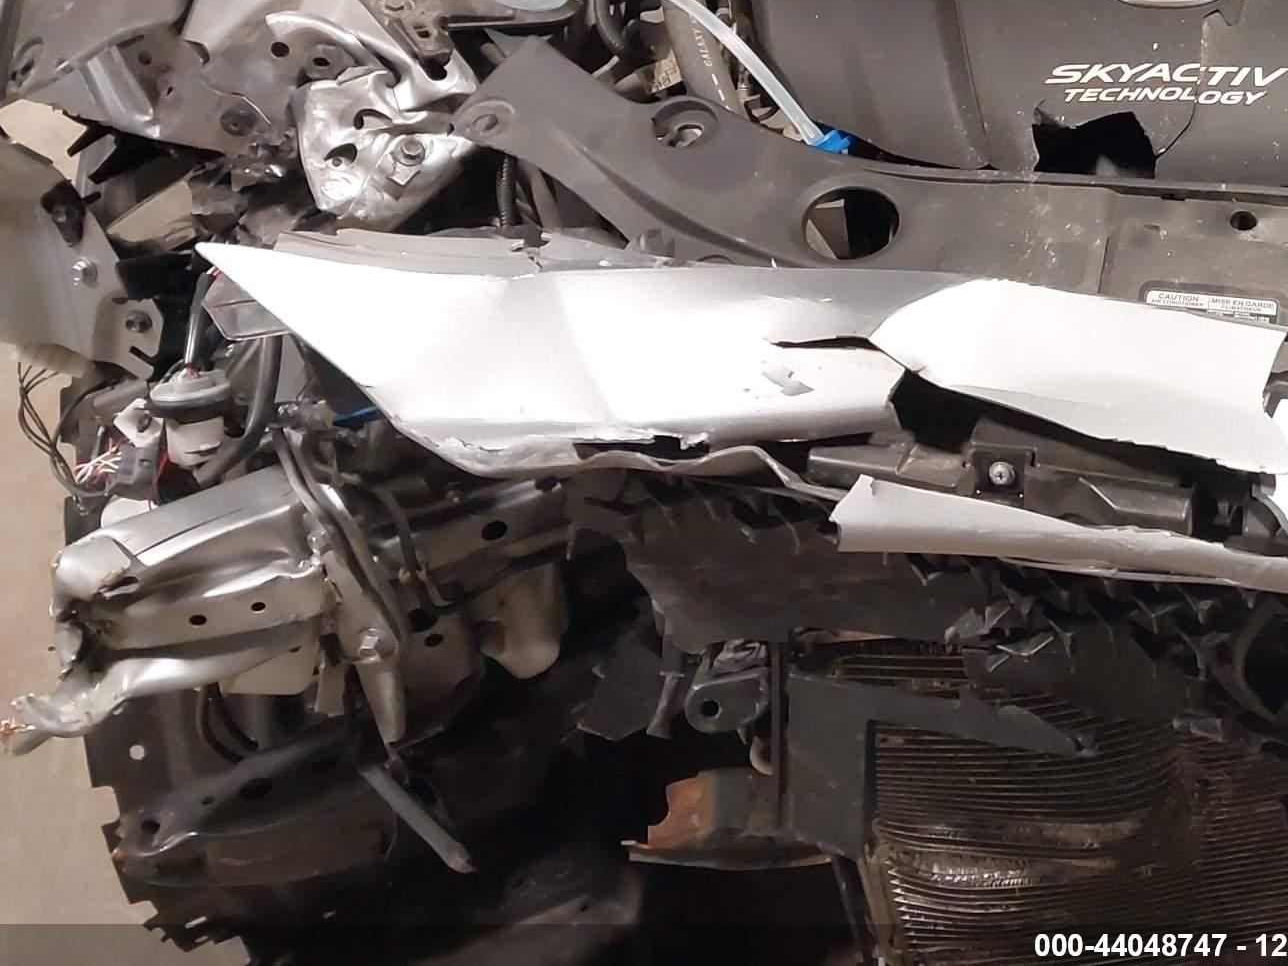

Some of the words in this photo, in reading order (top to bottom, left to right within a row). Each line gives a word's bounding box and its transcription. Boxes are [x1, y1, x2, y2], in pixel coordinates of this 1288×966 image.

[1045, 63, 1288, 87] SKYACTIV
[1064, 87, 1267, 105] TECHNOLOGY
[1158, 292, 1200, 303] CAUTION
[1211, 298, 1231, 306] MISE
[1245, 301, 1274, 309] GARDE
